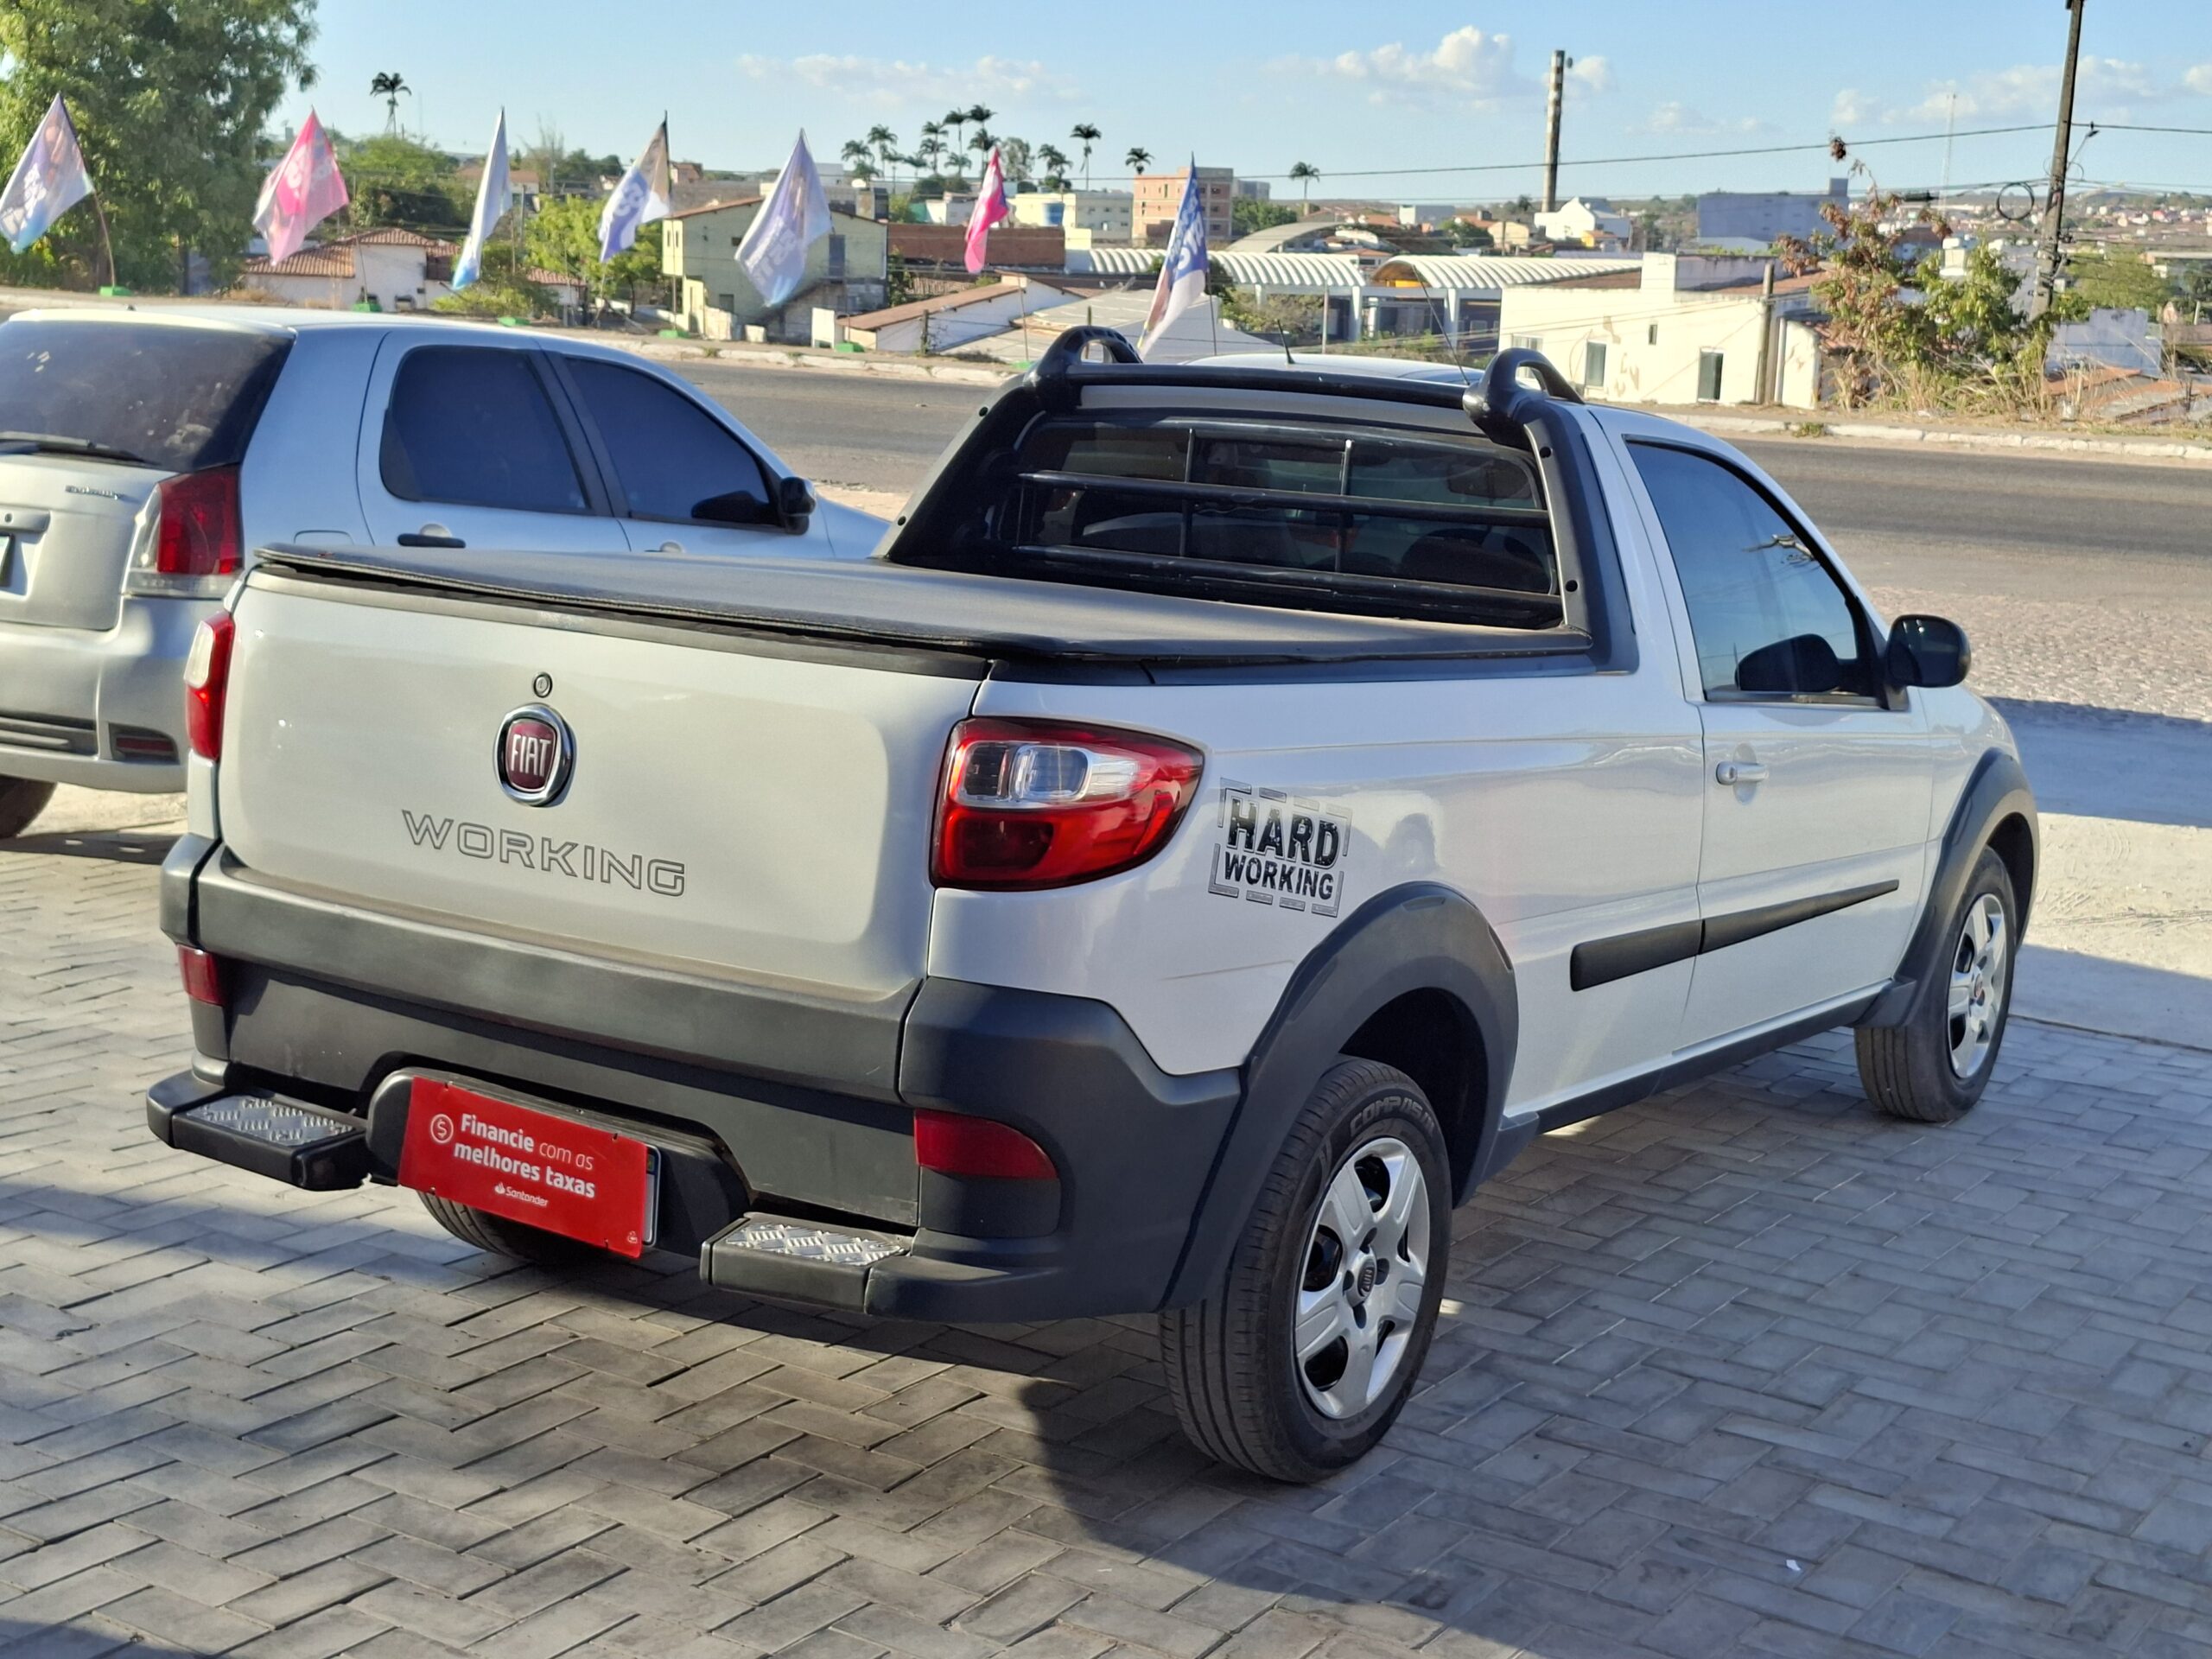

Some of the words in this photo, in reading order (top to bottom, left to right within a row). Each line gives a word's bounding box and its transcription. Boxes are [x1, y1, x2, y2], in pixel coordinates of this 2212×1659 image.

[511, 734, 551, 777] FIAT
[402, 810, 685, 897] WORKING
[1226, 797, 1340, 869] HARD
[1224, 851, 1334, 900] WORKING
[454, 1142, 541, 1181] melhores
[545, 1166, 595, 1198] taxas
[461, 1114, 535, 1153] Financie
[539, 1141, 571, 1164] com
[575, 1153, 594, 1171] as
[505, 1185, 549, 1207] Santander
